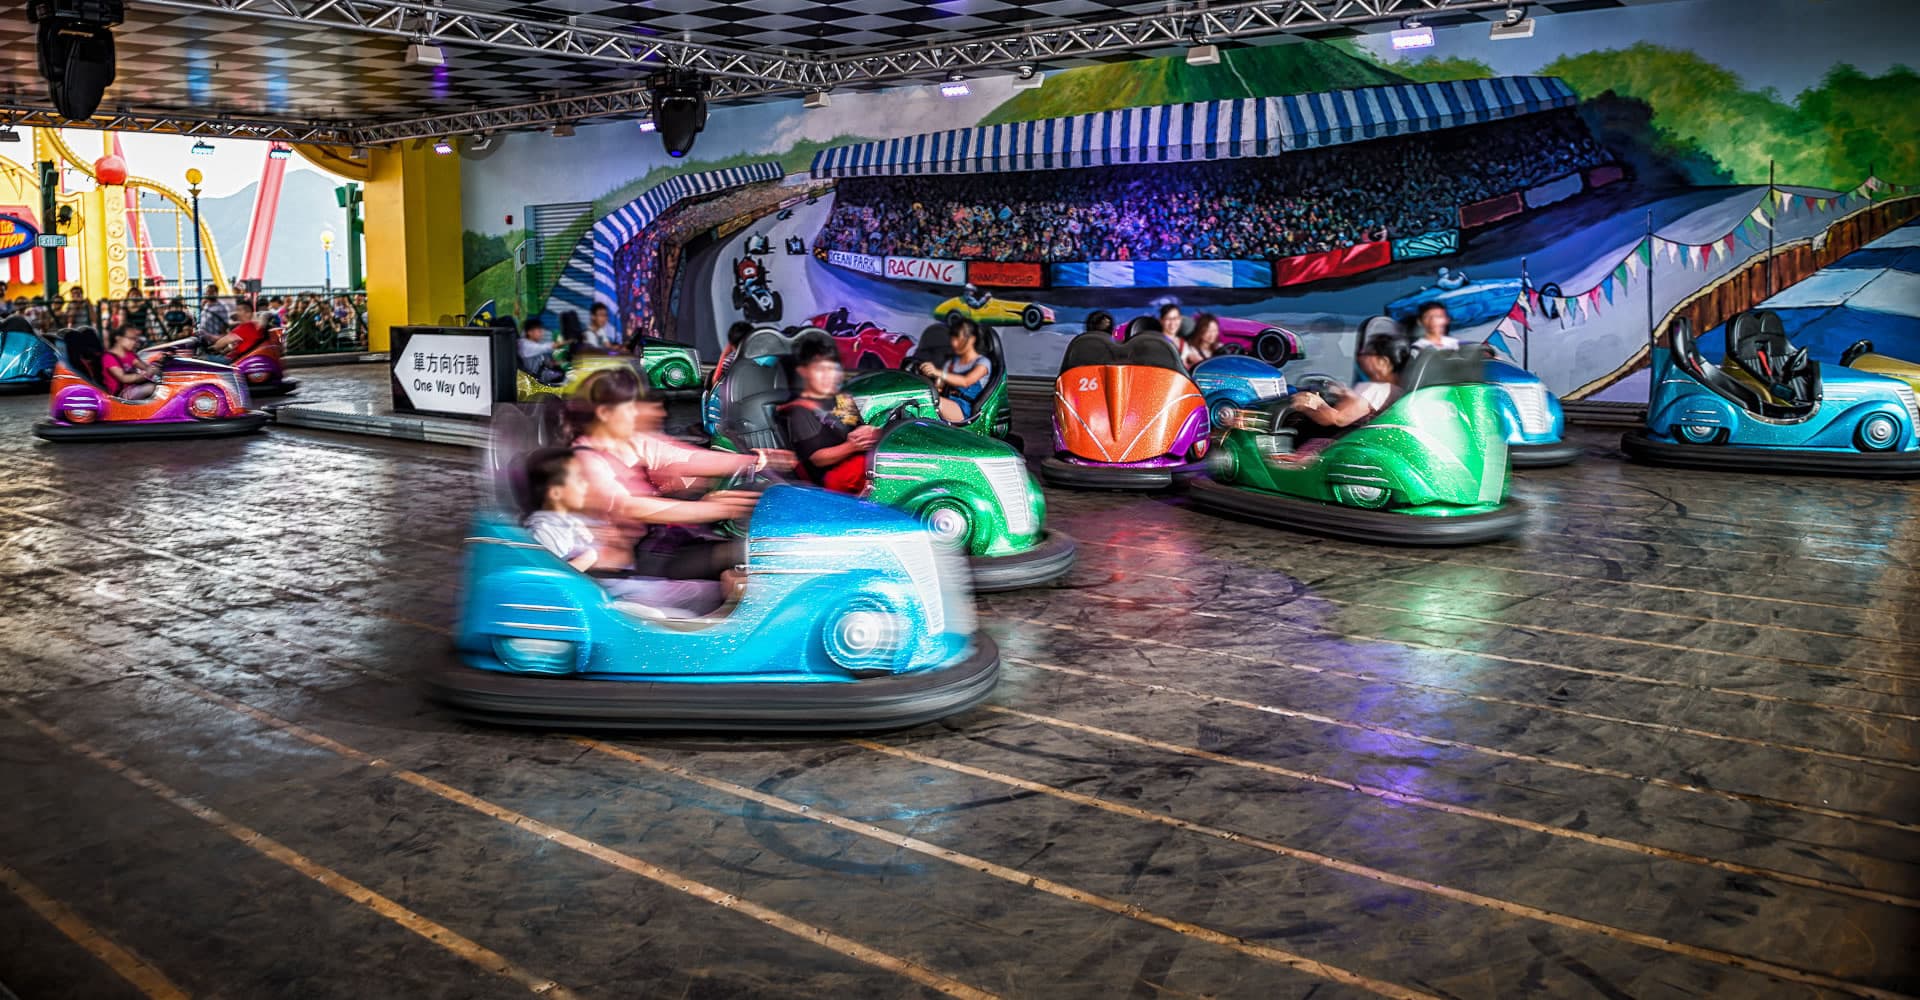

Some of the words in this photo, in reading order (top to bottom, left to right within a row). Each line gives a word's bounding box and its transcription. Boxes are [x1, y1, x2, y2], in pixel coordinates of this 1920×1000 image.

[888, 259, 954, 282] RACING
[413, 352, 480, 375] 單方向行駛
[413, 378, 433, 392] One
[436, 380, 455, 397] Way
[459, 381, 481, 399] Only
[1079, 377, 1098, 391] 26
